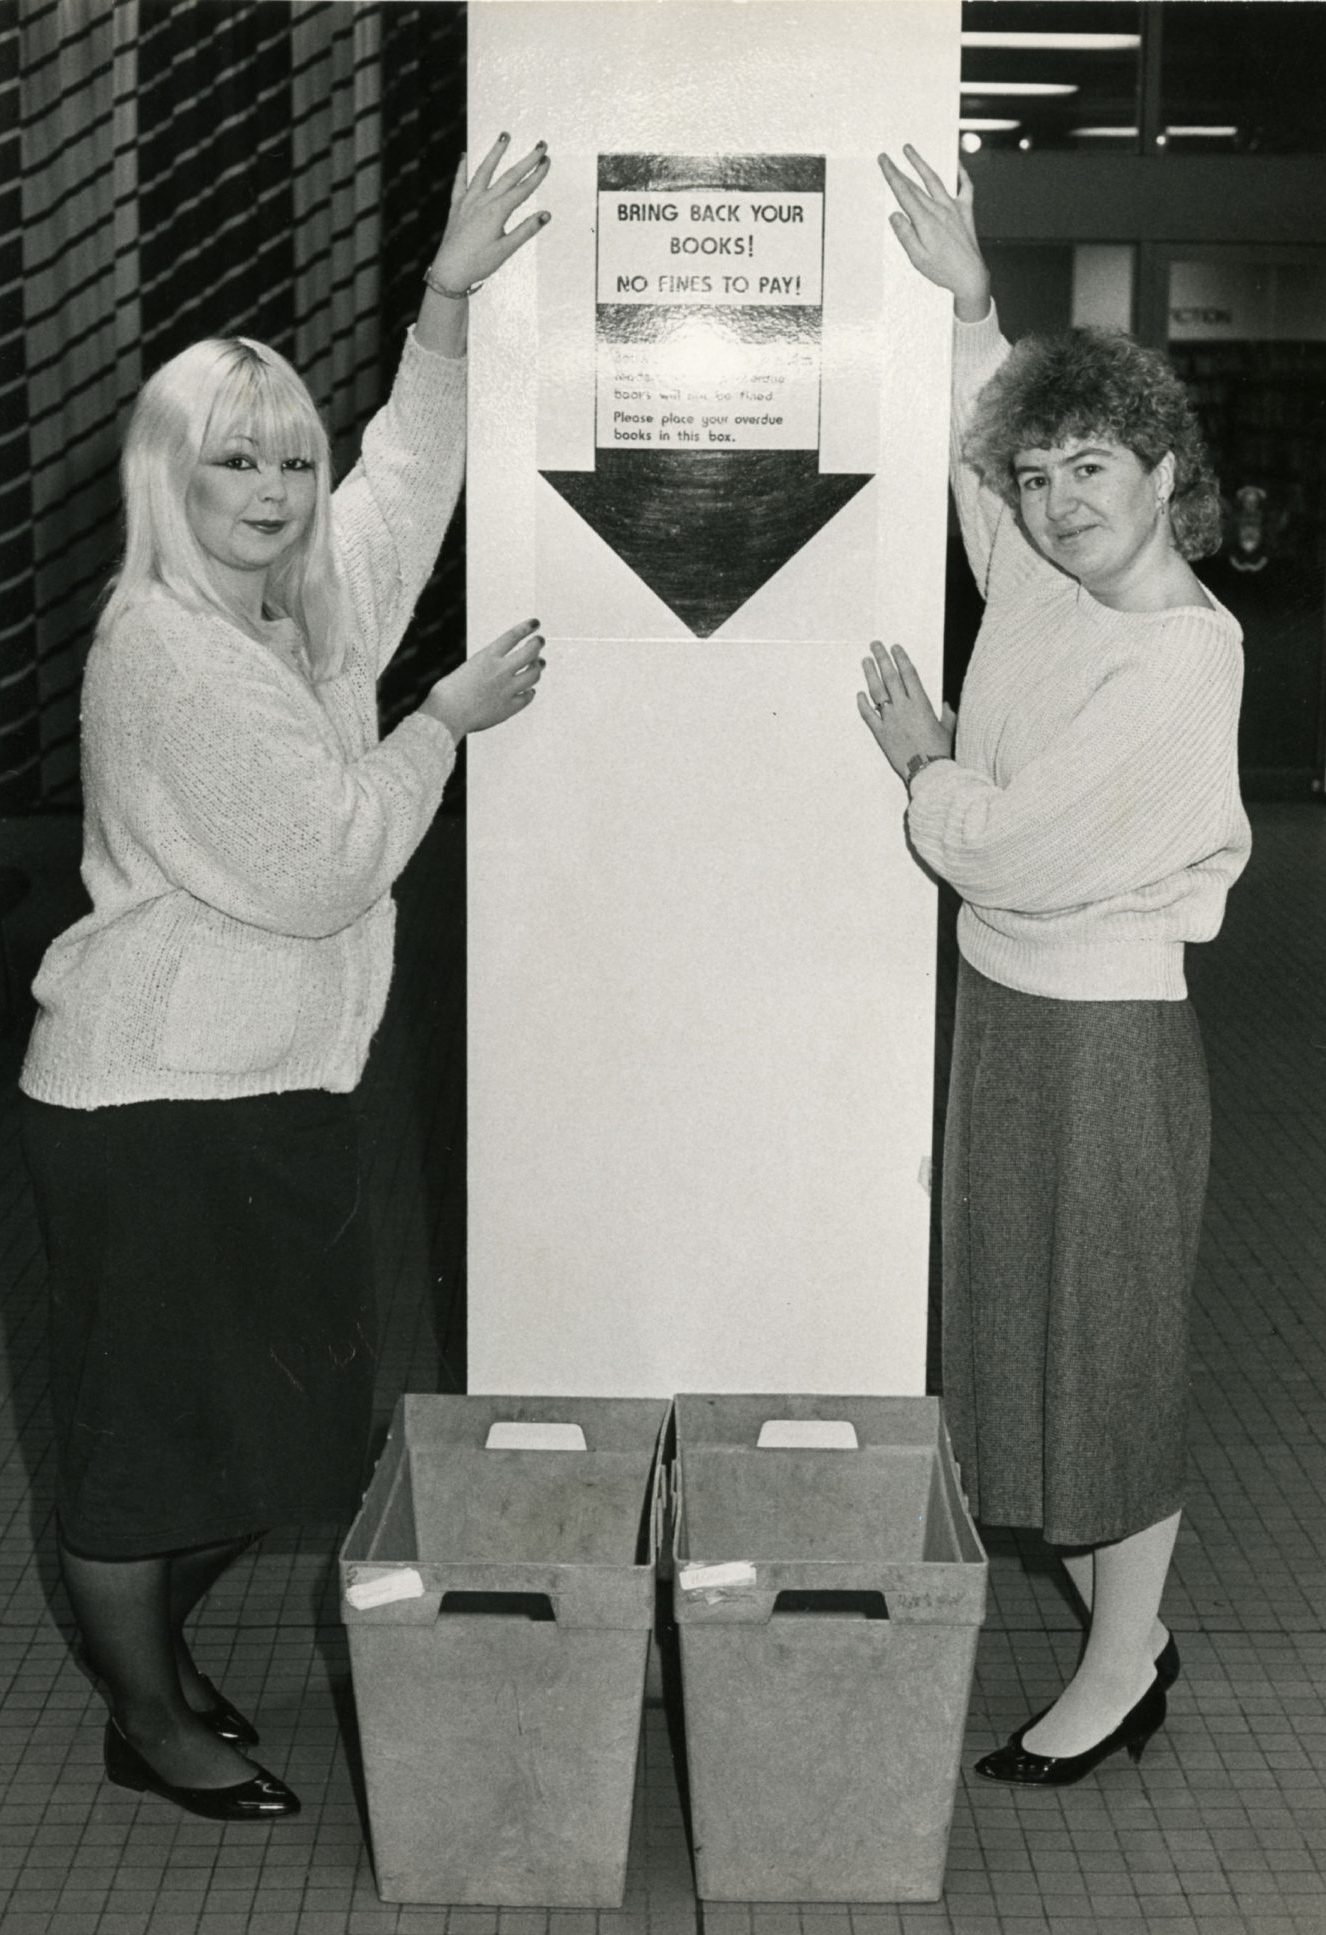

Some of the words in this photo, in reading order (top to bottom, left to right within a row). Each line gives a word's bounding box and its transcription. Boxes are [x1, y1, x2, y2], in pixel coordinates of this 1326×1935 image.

[617, 204, 679, 222] BRING
[690, 204, 741, 222] BACK
[751, 205, 804, 223] YOUR
[670, 235, 753, 257] BOOKS!
[616, 275, 649, 293] NO
[658, 275, 713, 293] FINES
[722, 276, 750, 294] TO
[758, 276, 801, 296] PAY!
[613, 410, 654, 424] Please
[660, 413, 694, 427] place
[701, 415, 729, 428] your
[734, 412, 784, 426] overdue
[613, 428, 652, 441] books
[658, 429, 671, 441] in
[677, 430, 700, 442] this
[708, 430, 737, 443] box.
